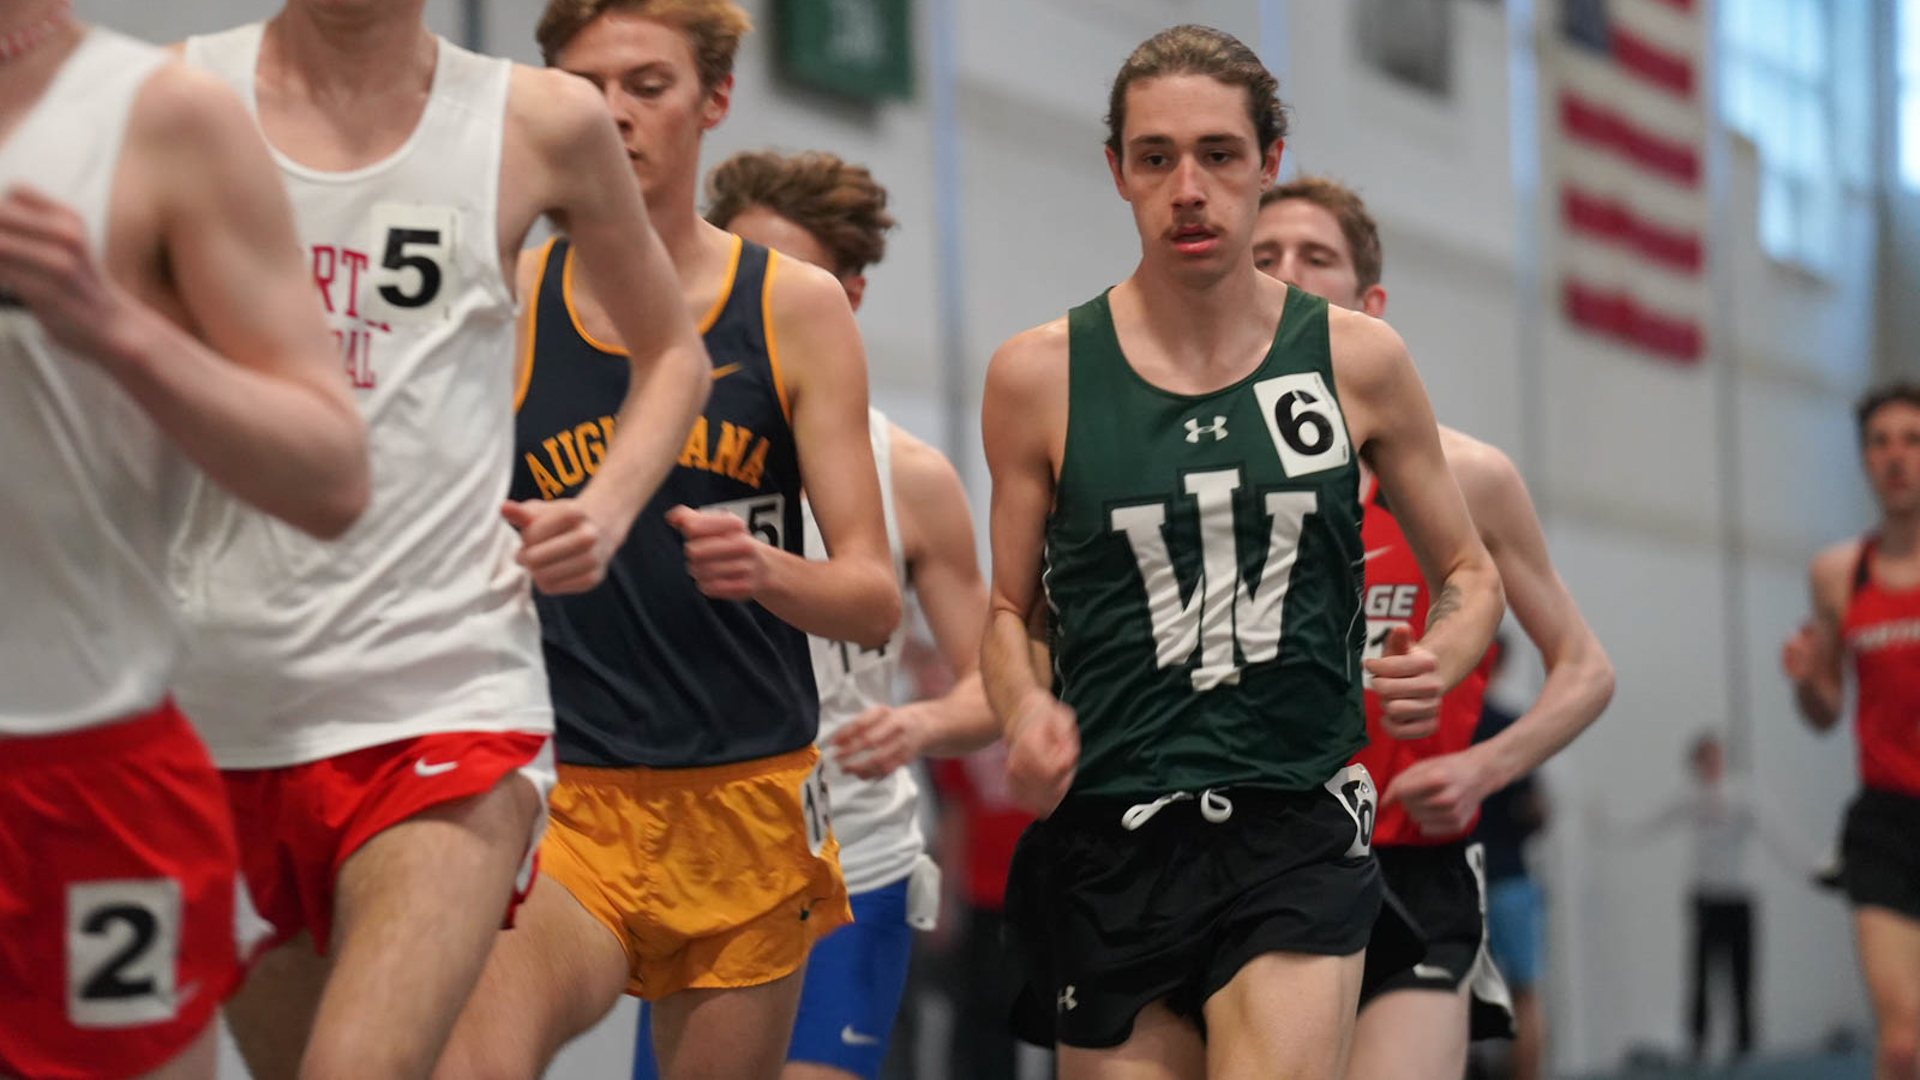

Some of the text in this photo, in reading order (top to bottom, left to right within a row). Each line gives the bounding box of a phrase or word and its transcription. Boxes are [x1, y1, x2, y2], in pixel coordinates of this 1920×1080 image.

[377, 228, 442, 308] 5
[525, 415, 770, 500] AUGANA
[1275, 389, 1335, 456] 6
[747, 502, 779, 549] 5
[1364, 585, 1419, 618] GE
[80, 905, 158, 1001] 2
